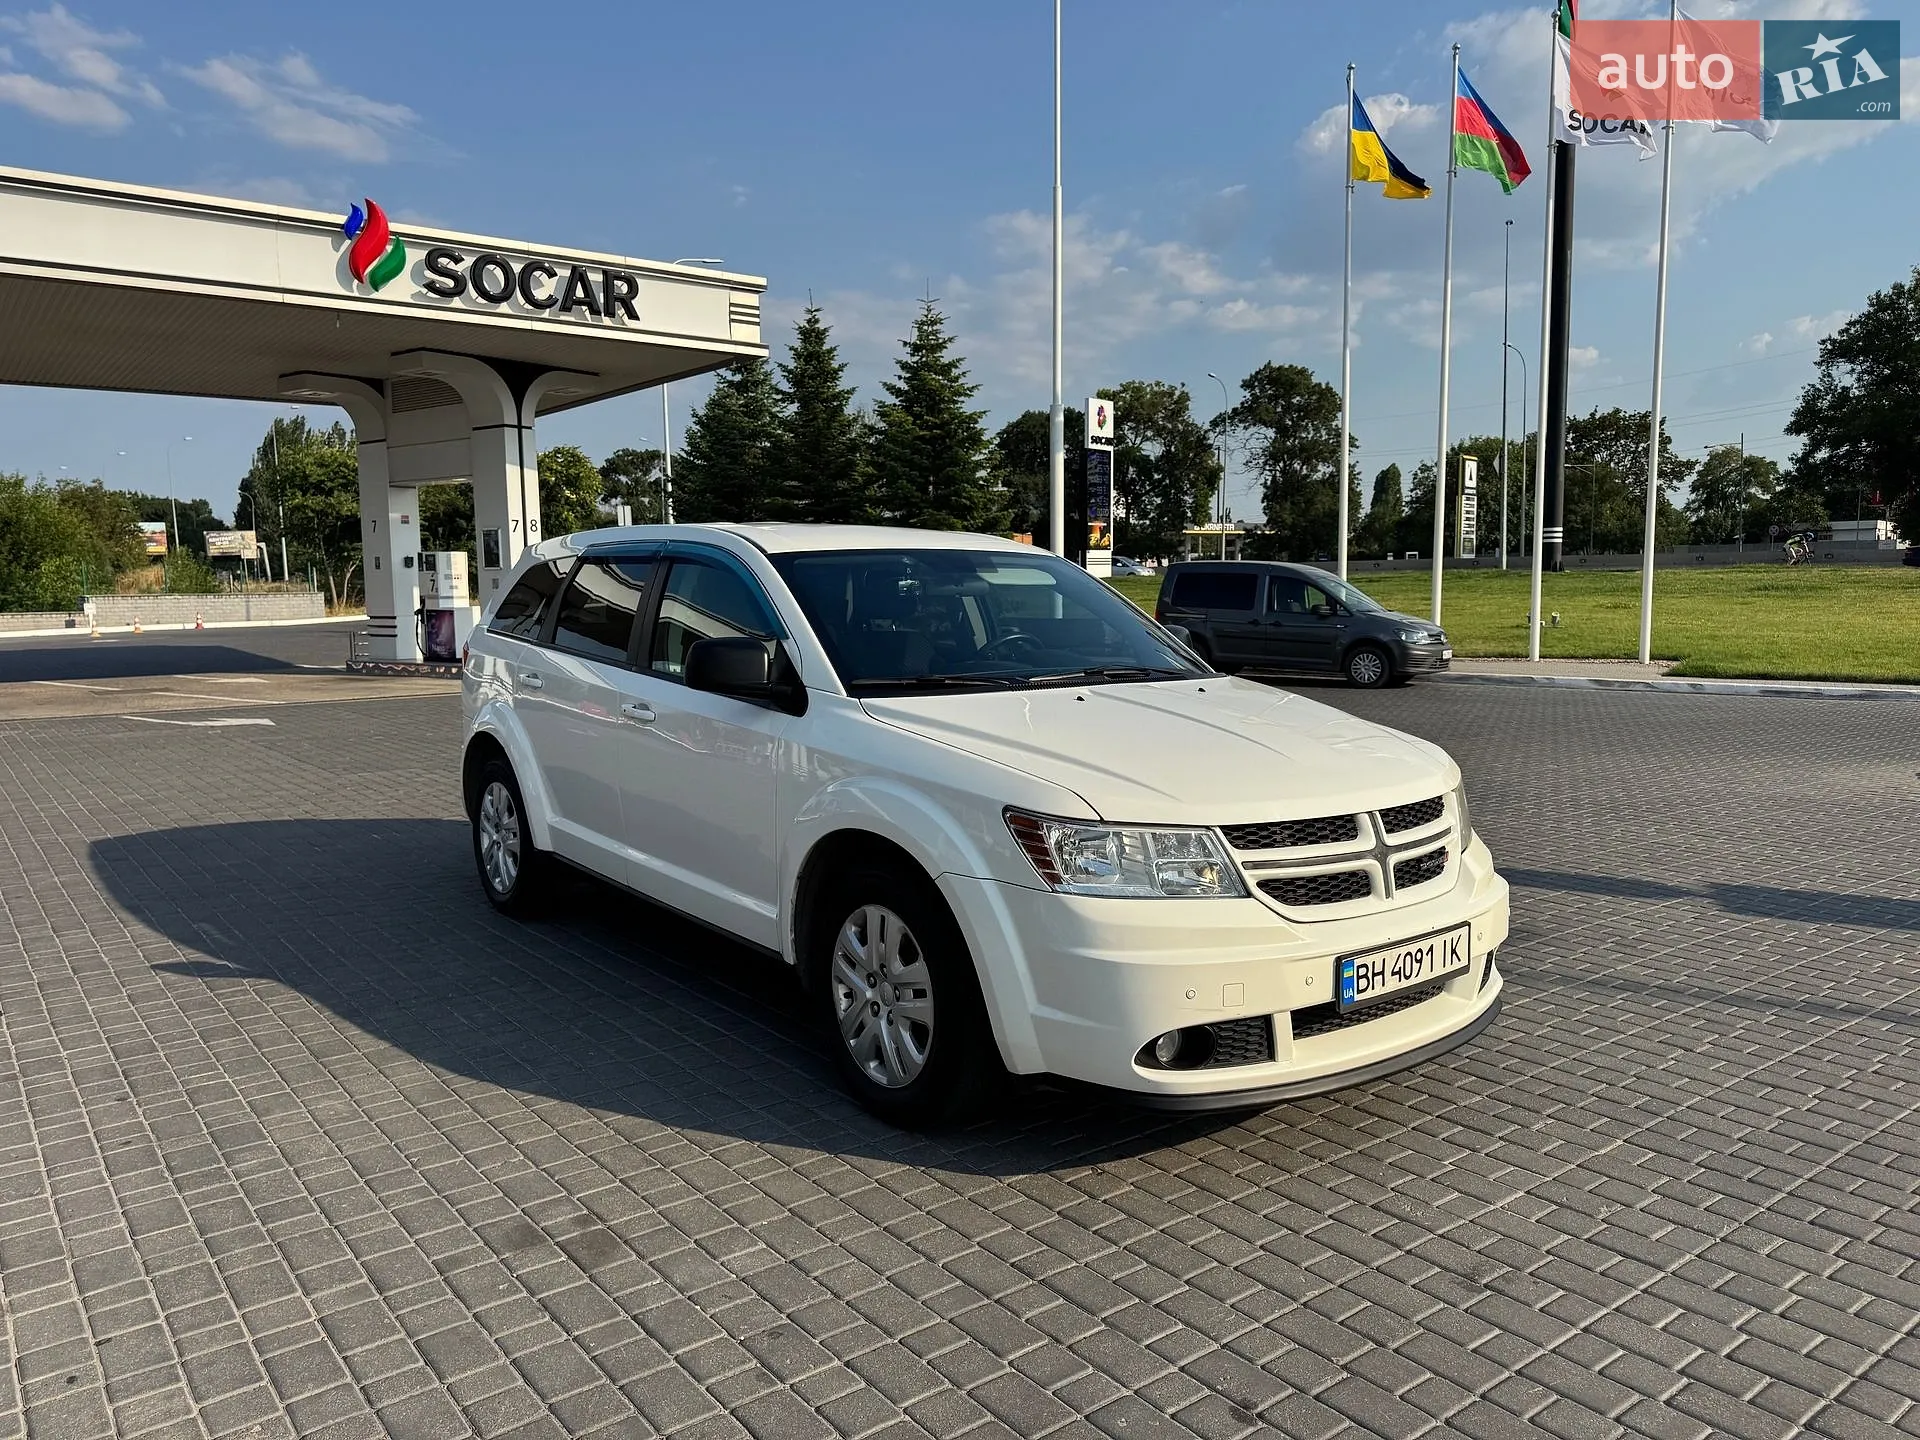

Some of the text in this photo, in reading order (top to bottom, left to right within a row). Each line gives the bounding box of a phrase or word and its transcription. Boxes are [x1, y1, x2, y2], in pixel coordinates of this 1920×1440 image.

[422, 247, 641, 322] SOCAR
[371, 520, 377, 533] 7
[511, 519, 519, 533] 7
[530, 519, 538, 532] 8
[429, 579, 436, 592] 7
[1356, 933, 1462, 995] BH 4091 IK
[1343, 987, 1354, 999] UA
